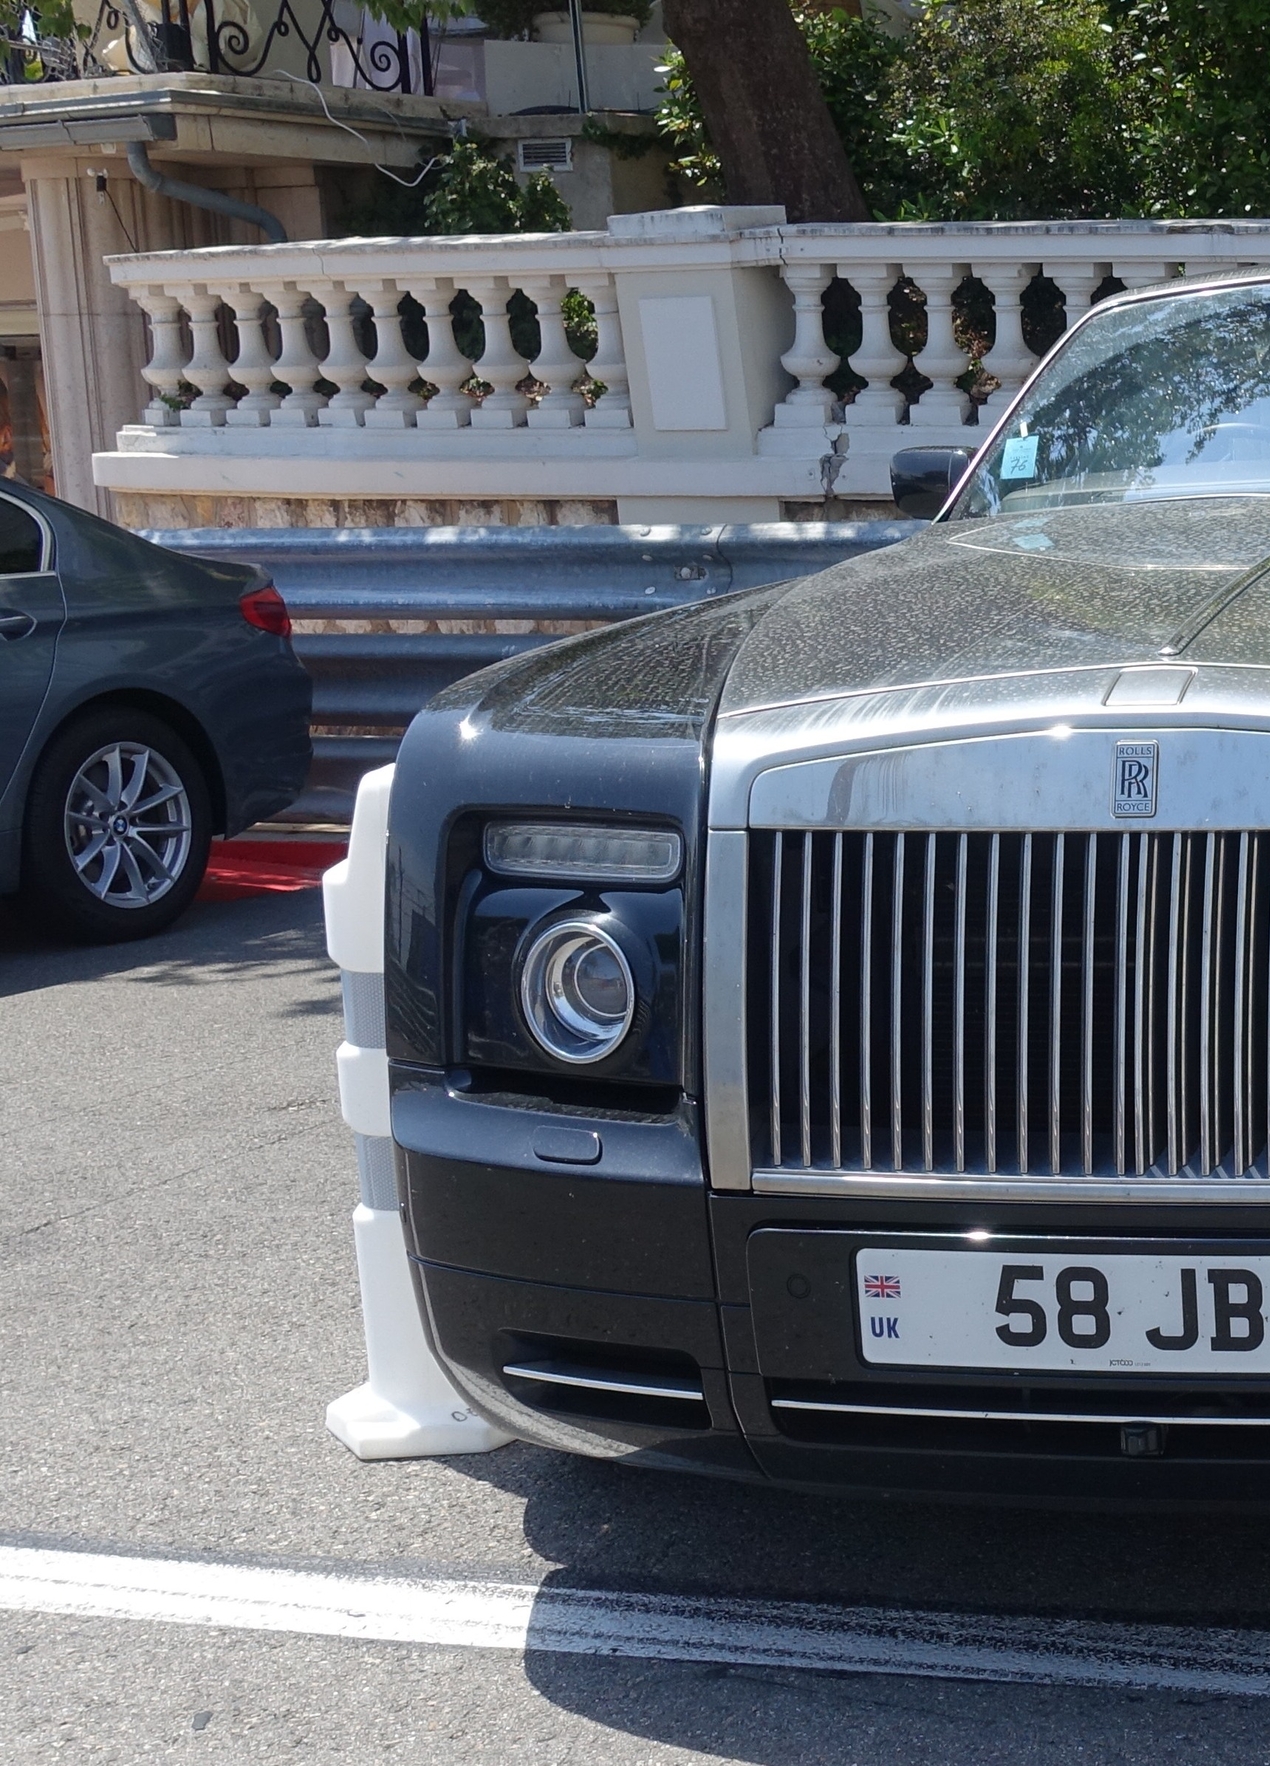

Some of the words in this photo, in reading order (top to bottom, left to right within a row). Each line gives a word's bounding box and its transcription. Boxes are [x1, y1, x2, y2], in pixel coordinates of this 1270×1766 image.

[1119, 747, 1152, 756] ROLLS
[1117, 803, 1150, 812] ROYCE
[994, 1264, 1112, 1350] 58
[1144, 1267, 1266, 1353] JB
[869, 1316, 901, 1340] UK
